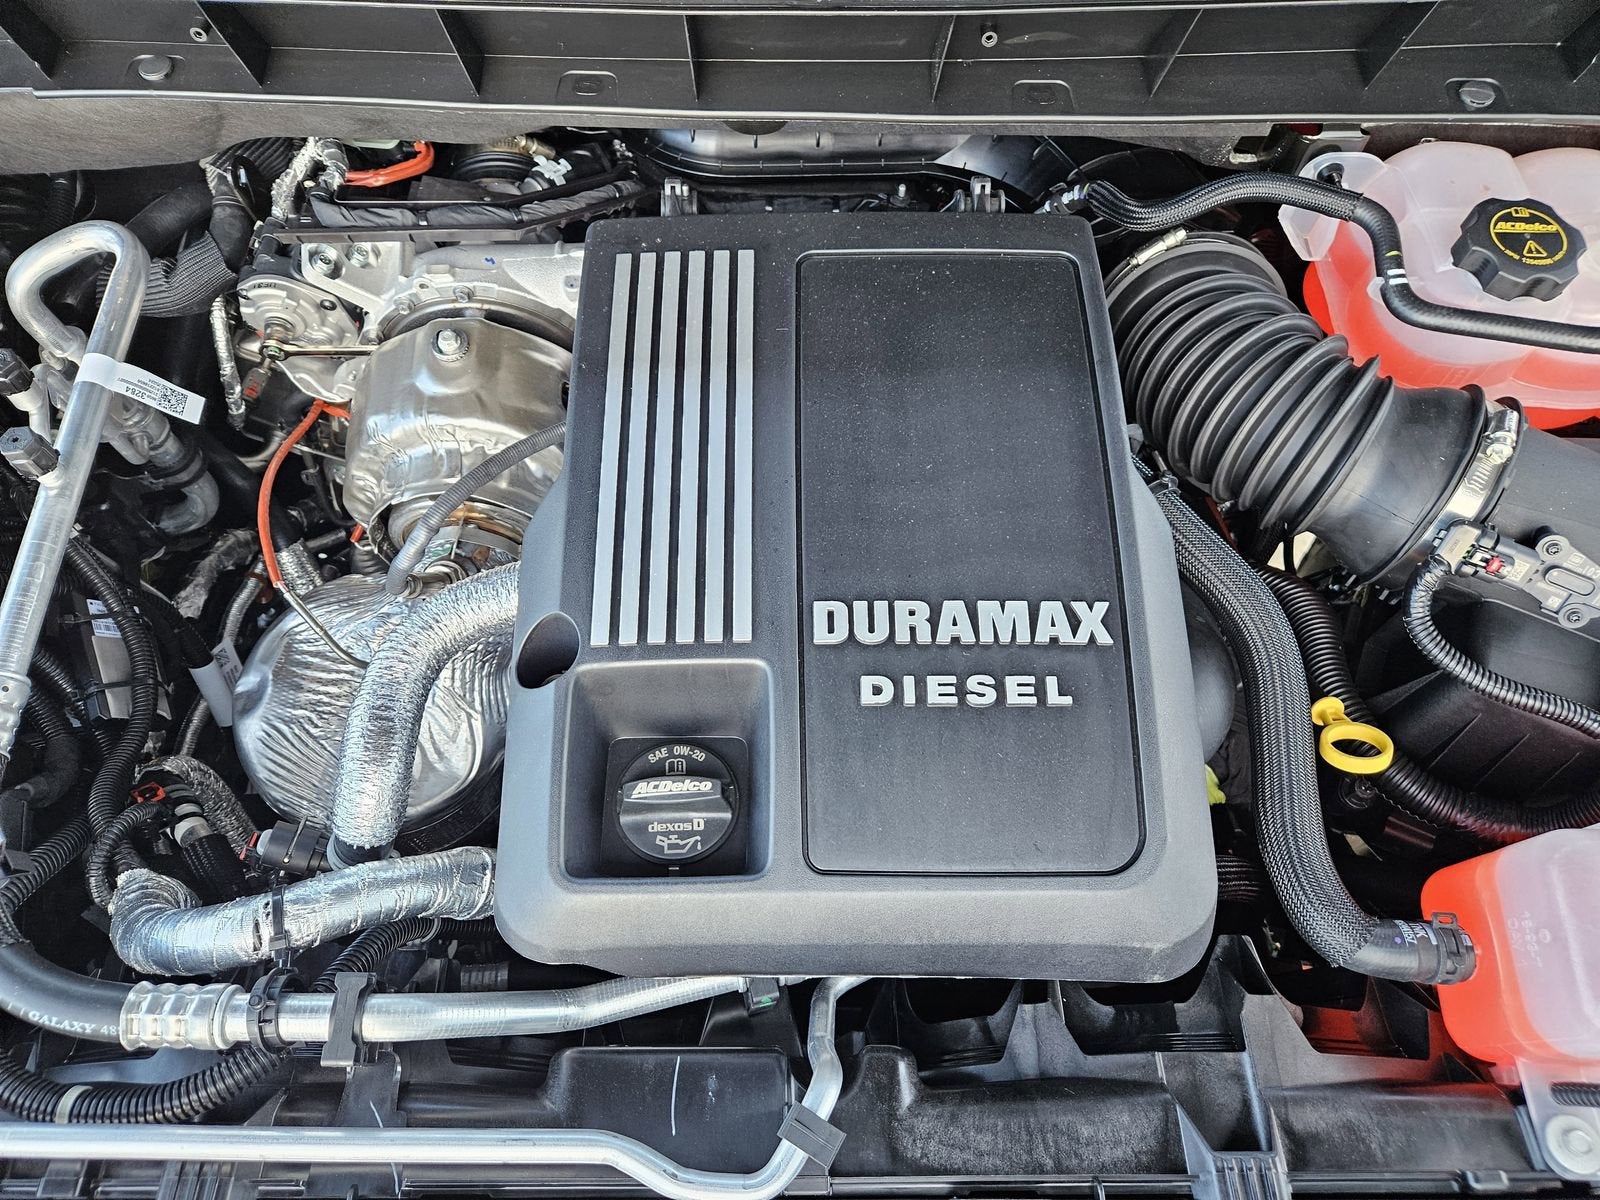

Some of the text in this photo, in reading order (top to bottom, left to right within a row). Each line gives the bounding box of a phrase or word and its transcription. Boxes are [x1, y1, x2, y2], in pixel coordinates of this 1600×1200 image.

[1494, 221, 1559, 233] ACDelco
[812, 600, 1114, 646] DURAMAX
[860, 674, 1074, 708] DIESEL
[647, 745, 706, 764] SAE 0W-20
[631, 778, 713, 797] ACDelco
[28, 1010, 97, 1034] GALAXY
